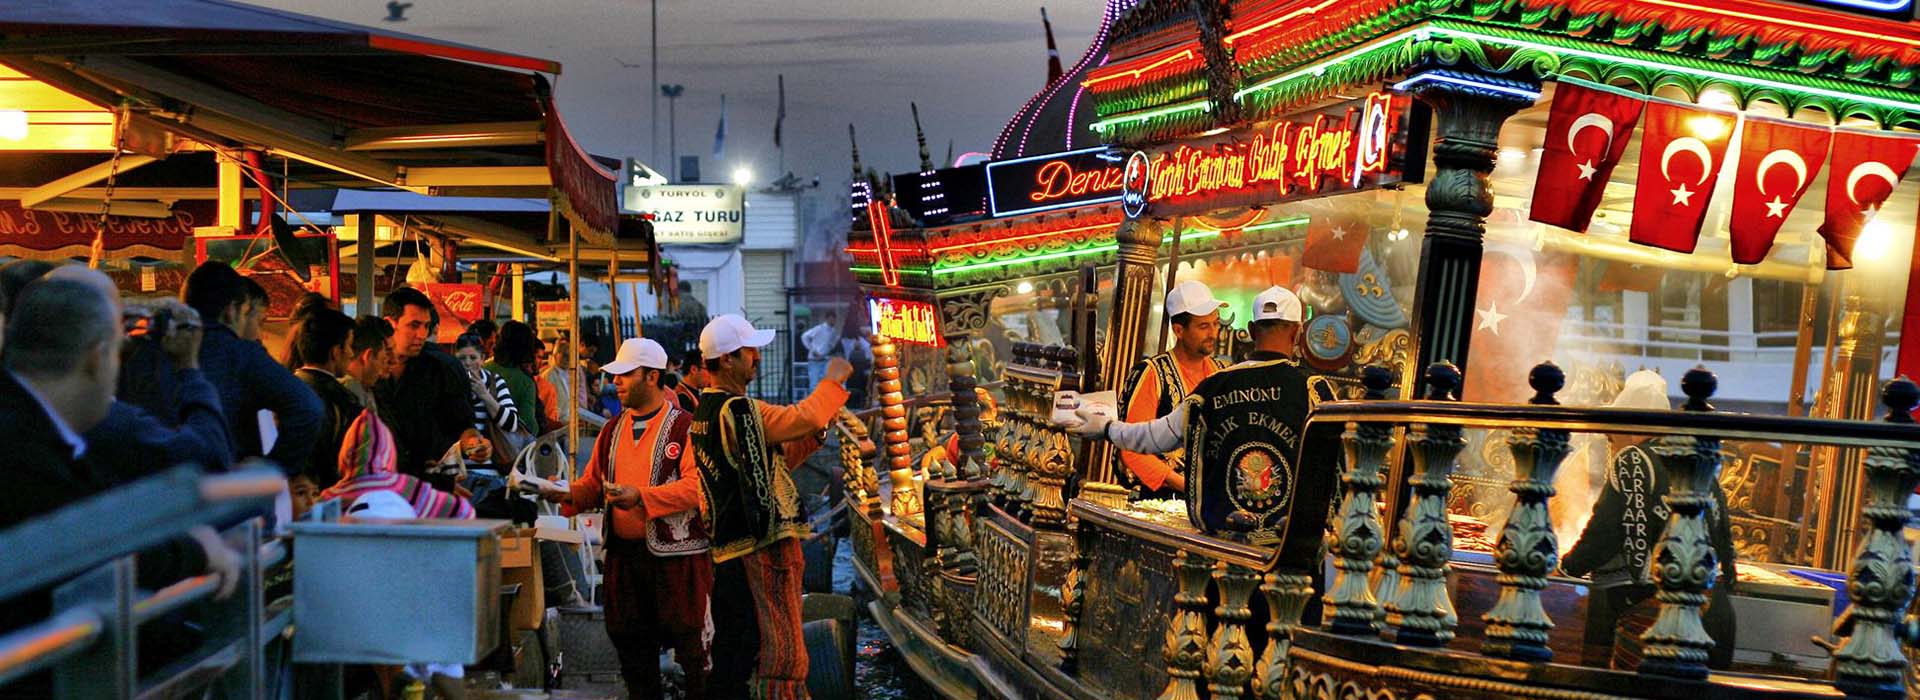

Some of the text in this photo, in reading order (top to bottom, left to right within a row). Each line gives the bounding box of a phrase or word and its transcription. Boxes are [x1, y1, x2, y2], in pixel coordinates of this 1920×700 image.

[1294, 107, 1354, 190] Ekmek
[1031, 161, 1123, 200] Deniz
[694, 210, 740, 223] TURU
[445, 291, 477, 312] Cola
[1248, 411, 1299, 449] EKMEK
[743, 413, 772, 509] BARBAROS
[1631, 451, 1647, 568] BARBAROS
